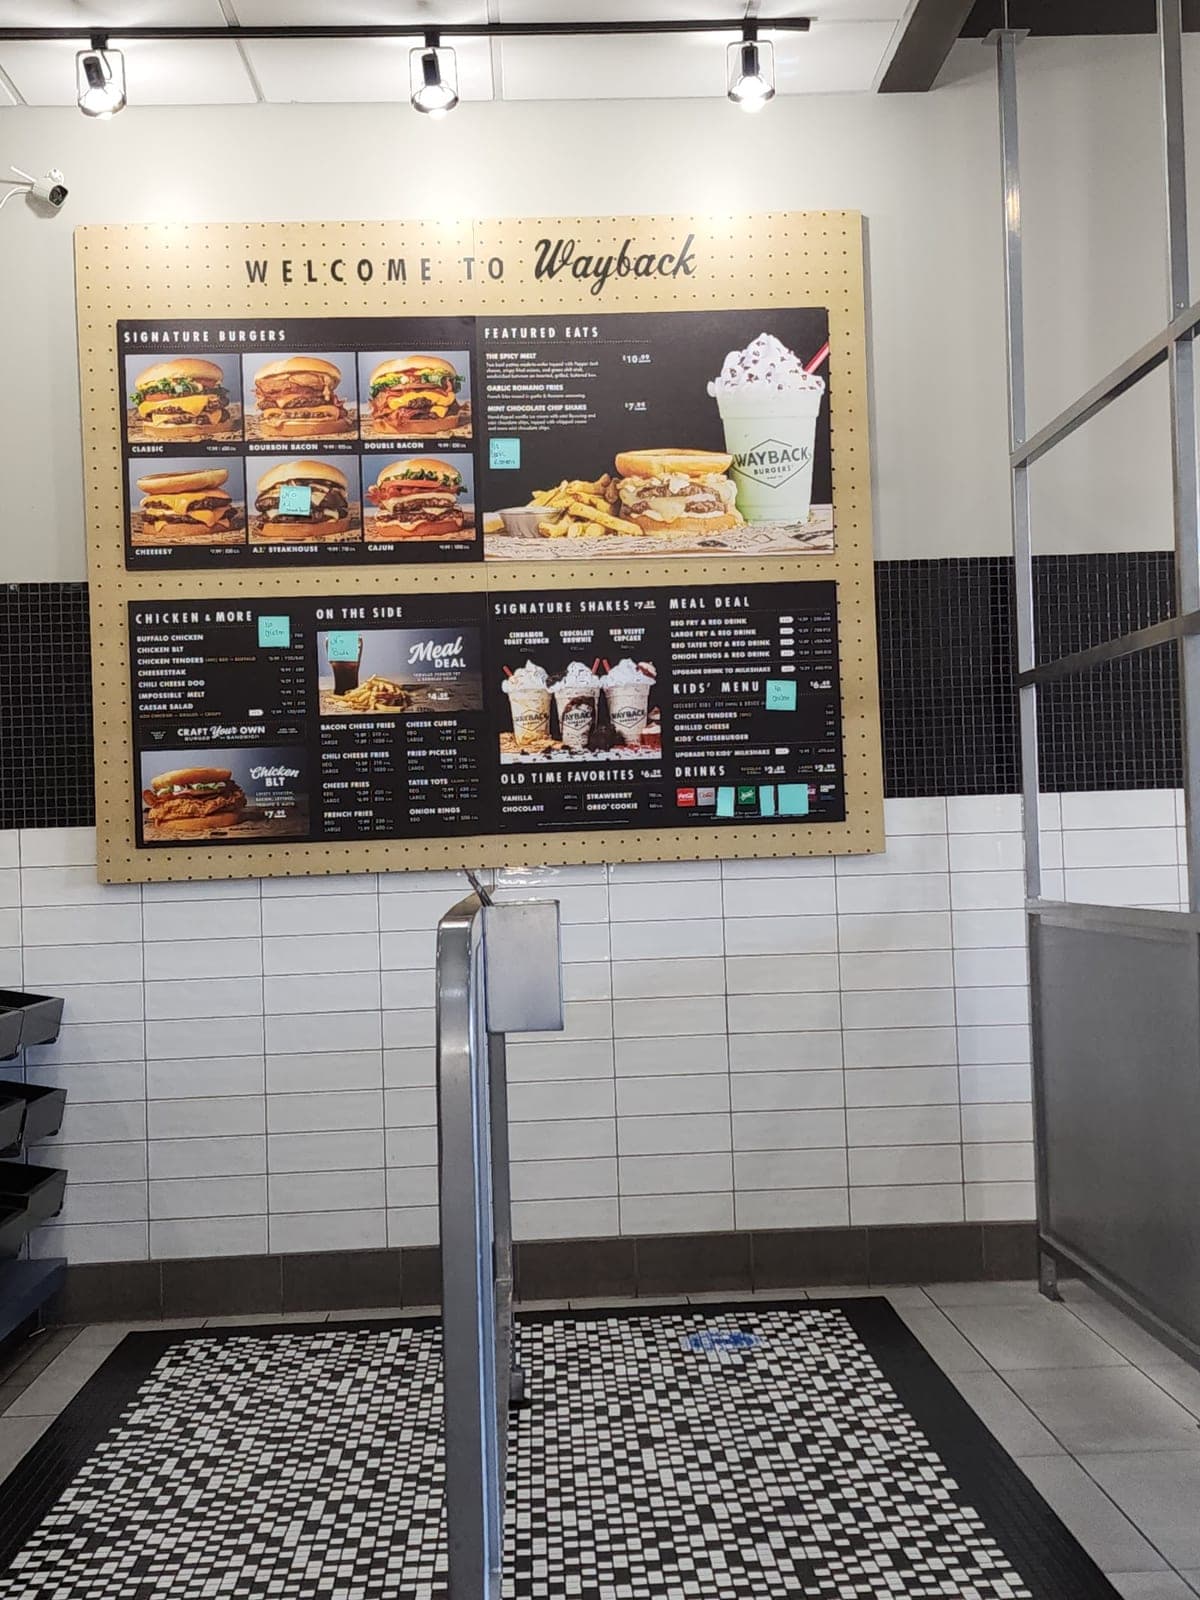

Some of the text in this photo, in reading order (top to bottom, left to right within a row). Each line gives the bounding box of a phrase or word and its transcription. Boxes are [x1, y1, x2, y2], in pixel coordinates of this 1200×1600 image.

[245, 233, 697, 296] WELCOME TO Wayback
[123, 330, 286, 342] SIGNATURE BURGERS
[484, 327, 599, 339] FEATURED EATS
[734, 446, 808, 468] WAYBACK
[753, 465, 791, 475] BURGERS
[268, 545, 319, 554] STEAKHOUSE
[494, 600, 630, 615] SIGNATURE SHAKES
[669, 597, 750, 609] MEAL DEAL
[135, 611, 252, 624] CHICKEN & MORE
[316, 607, 403, 619] ON THE SIDE
[407, 636, 463, 665] Meal
[434, 658, 466, 668] DEAL
[138, 669, 186, 677] CHEESESTEAK
[721, 681, 759, 692] MENU
[177, 726, 265, 739] CRAFT Your OWN
[250, 766, 300, 779] Chicken
[501, 770, 634, 784] OLD TIME FAVORITES
[675, 766, 725, 777] DRINKS
[265, 778, 285, 787] BLT
[587, 792, 632, 800] STRAWBERRY
[502, 805, 544, 813] CHOCOLATE
